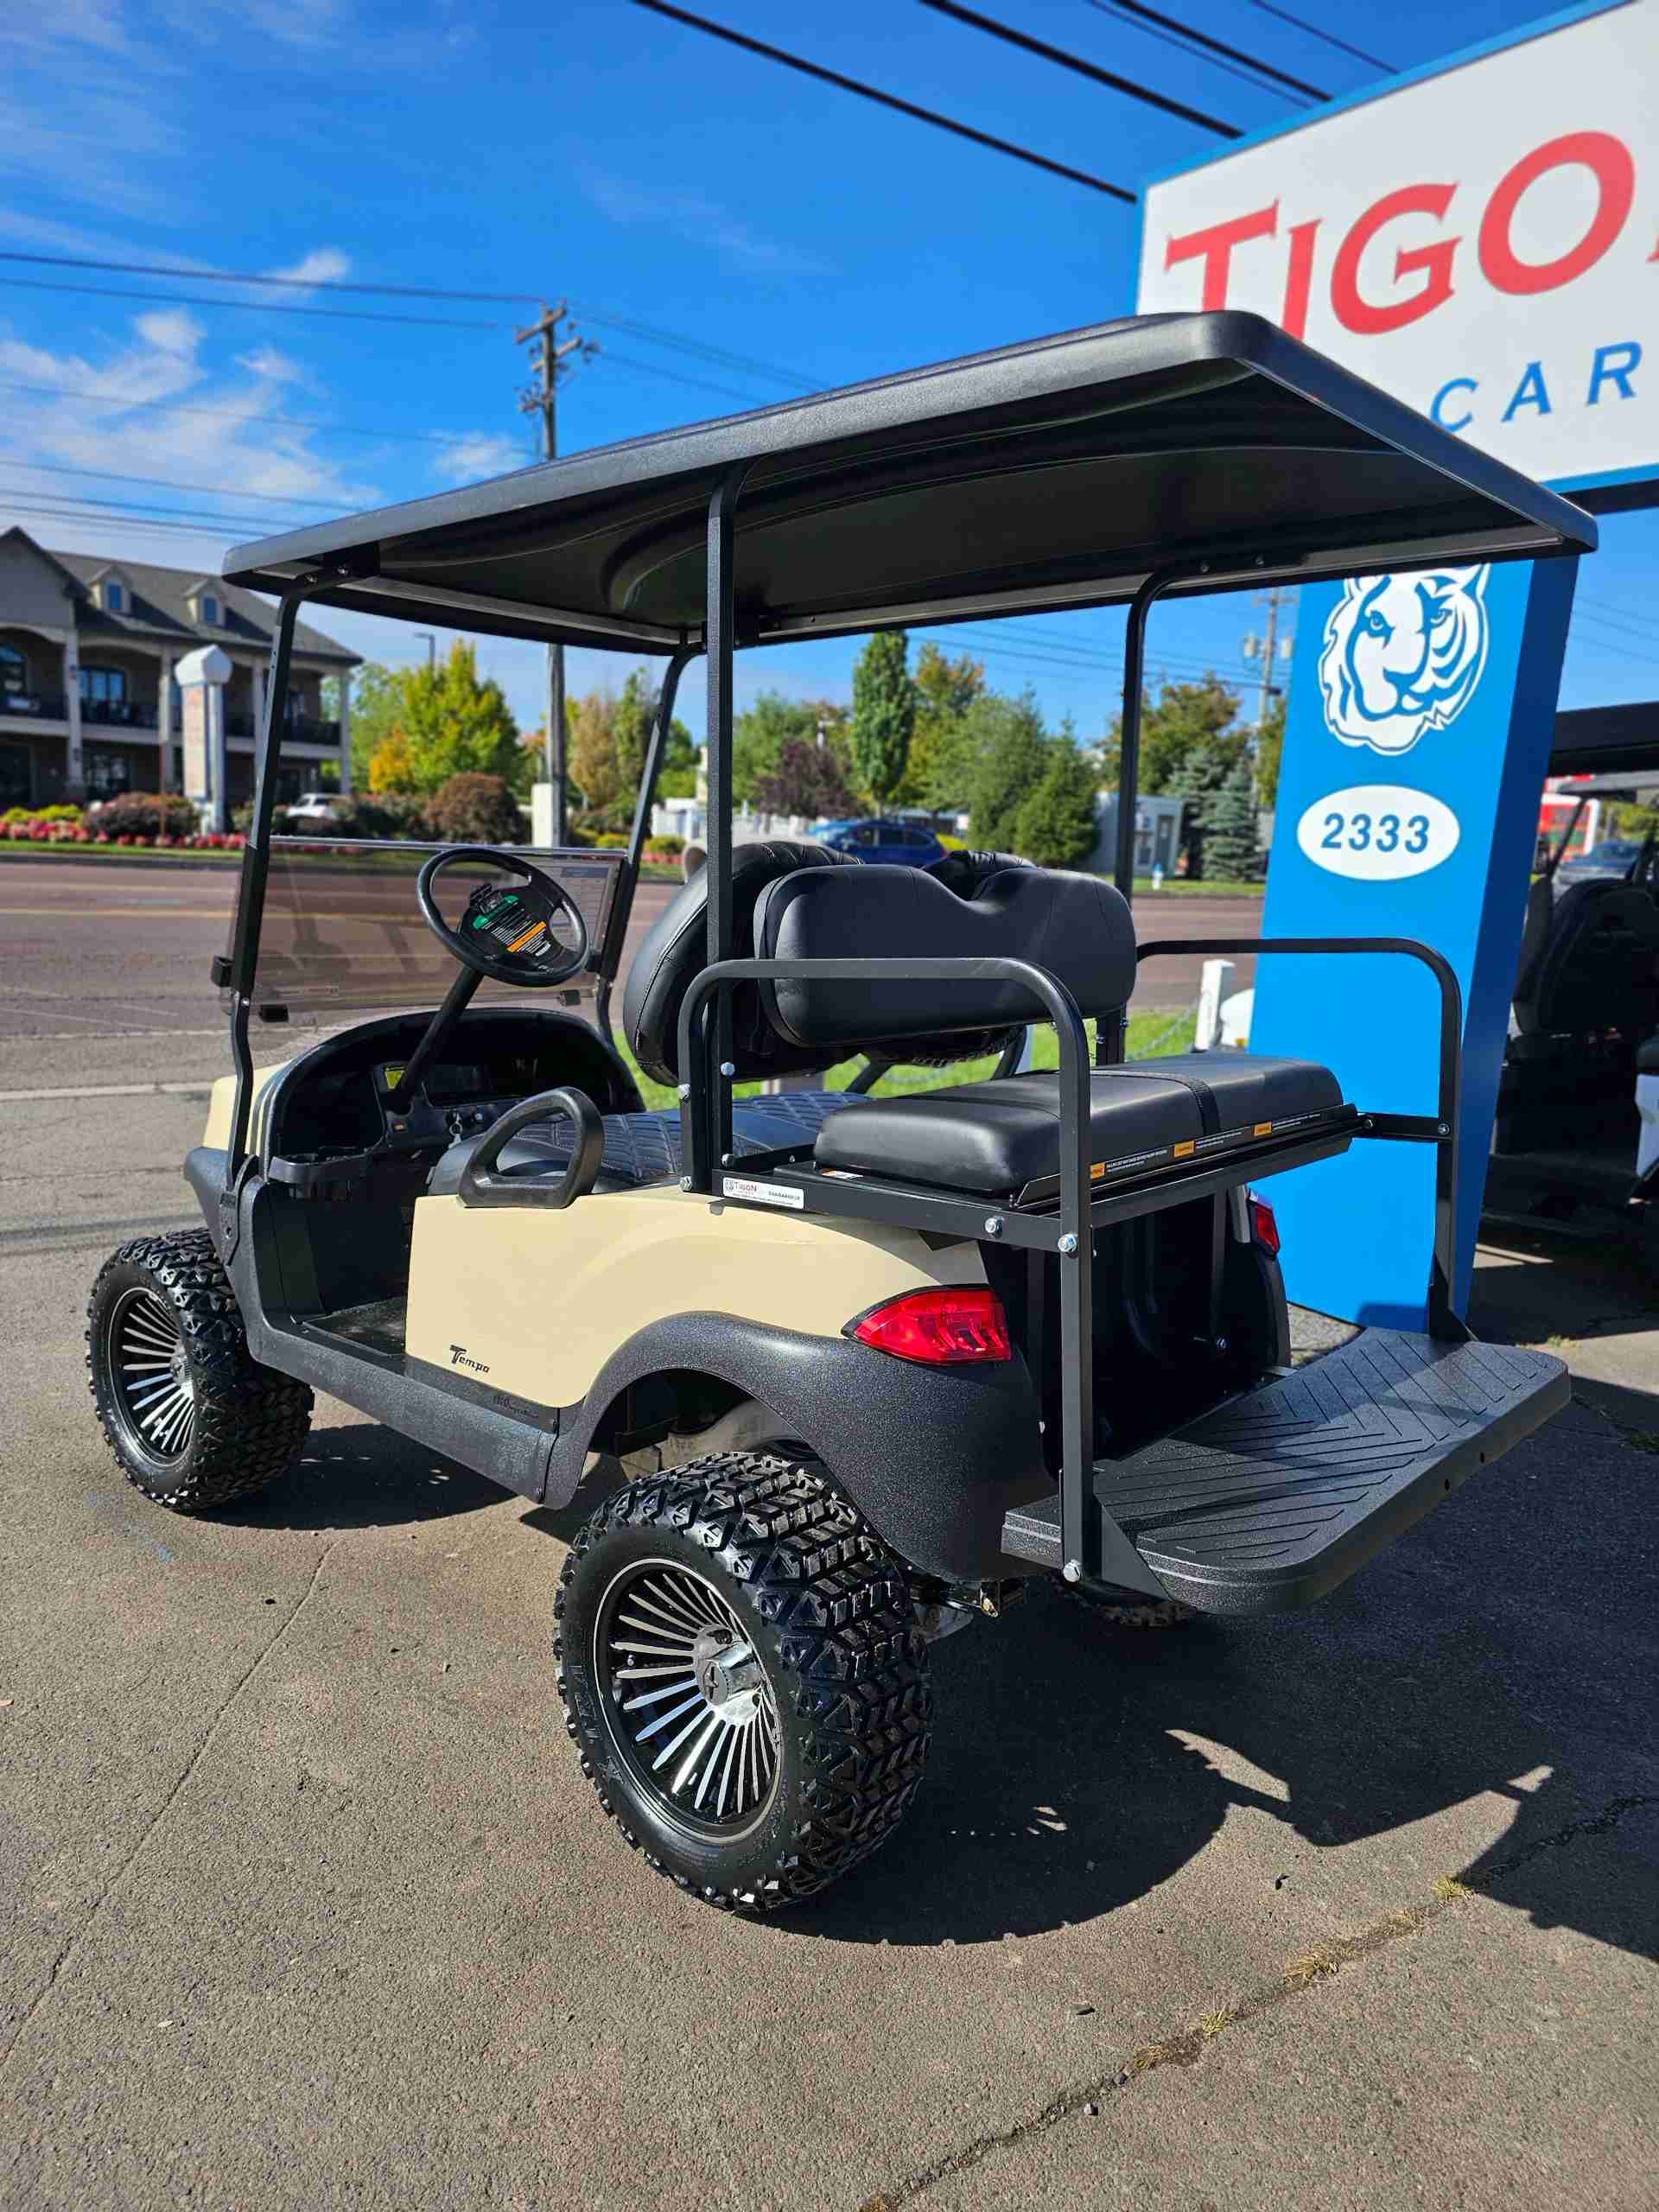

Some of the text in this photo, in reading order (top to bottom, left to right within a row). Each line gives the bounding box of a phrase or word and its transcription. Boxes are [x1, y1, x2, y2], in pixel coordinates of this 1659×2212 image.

[1164, 130, 1659, 340] TIGO
[1429, 340, 1643, 433] CAR
[1320, 812, 1430, 855] 2333
[449, 1344, 491, 1373] Tempo
